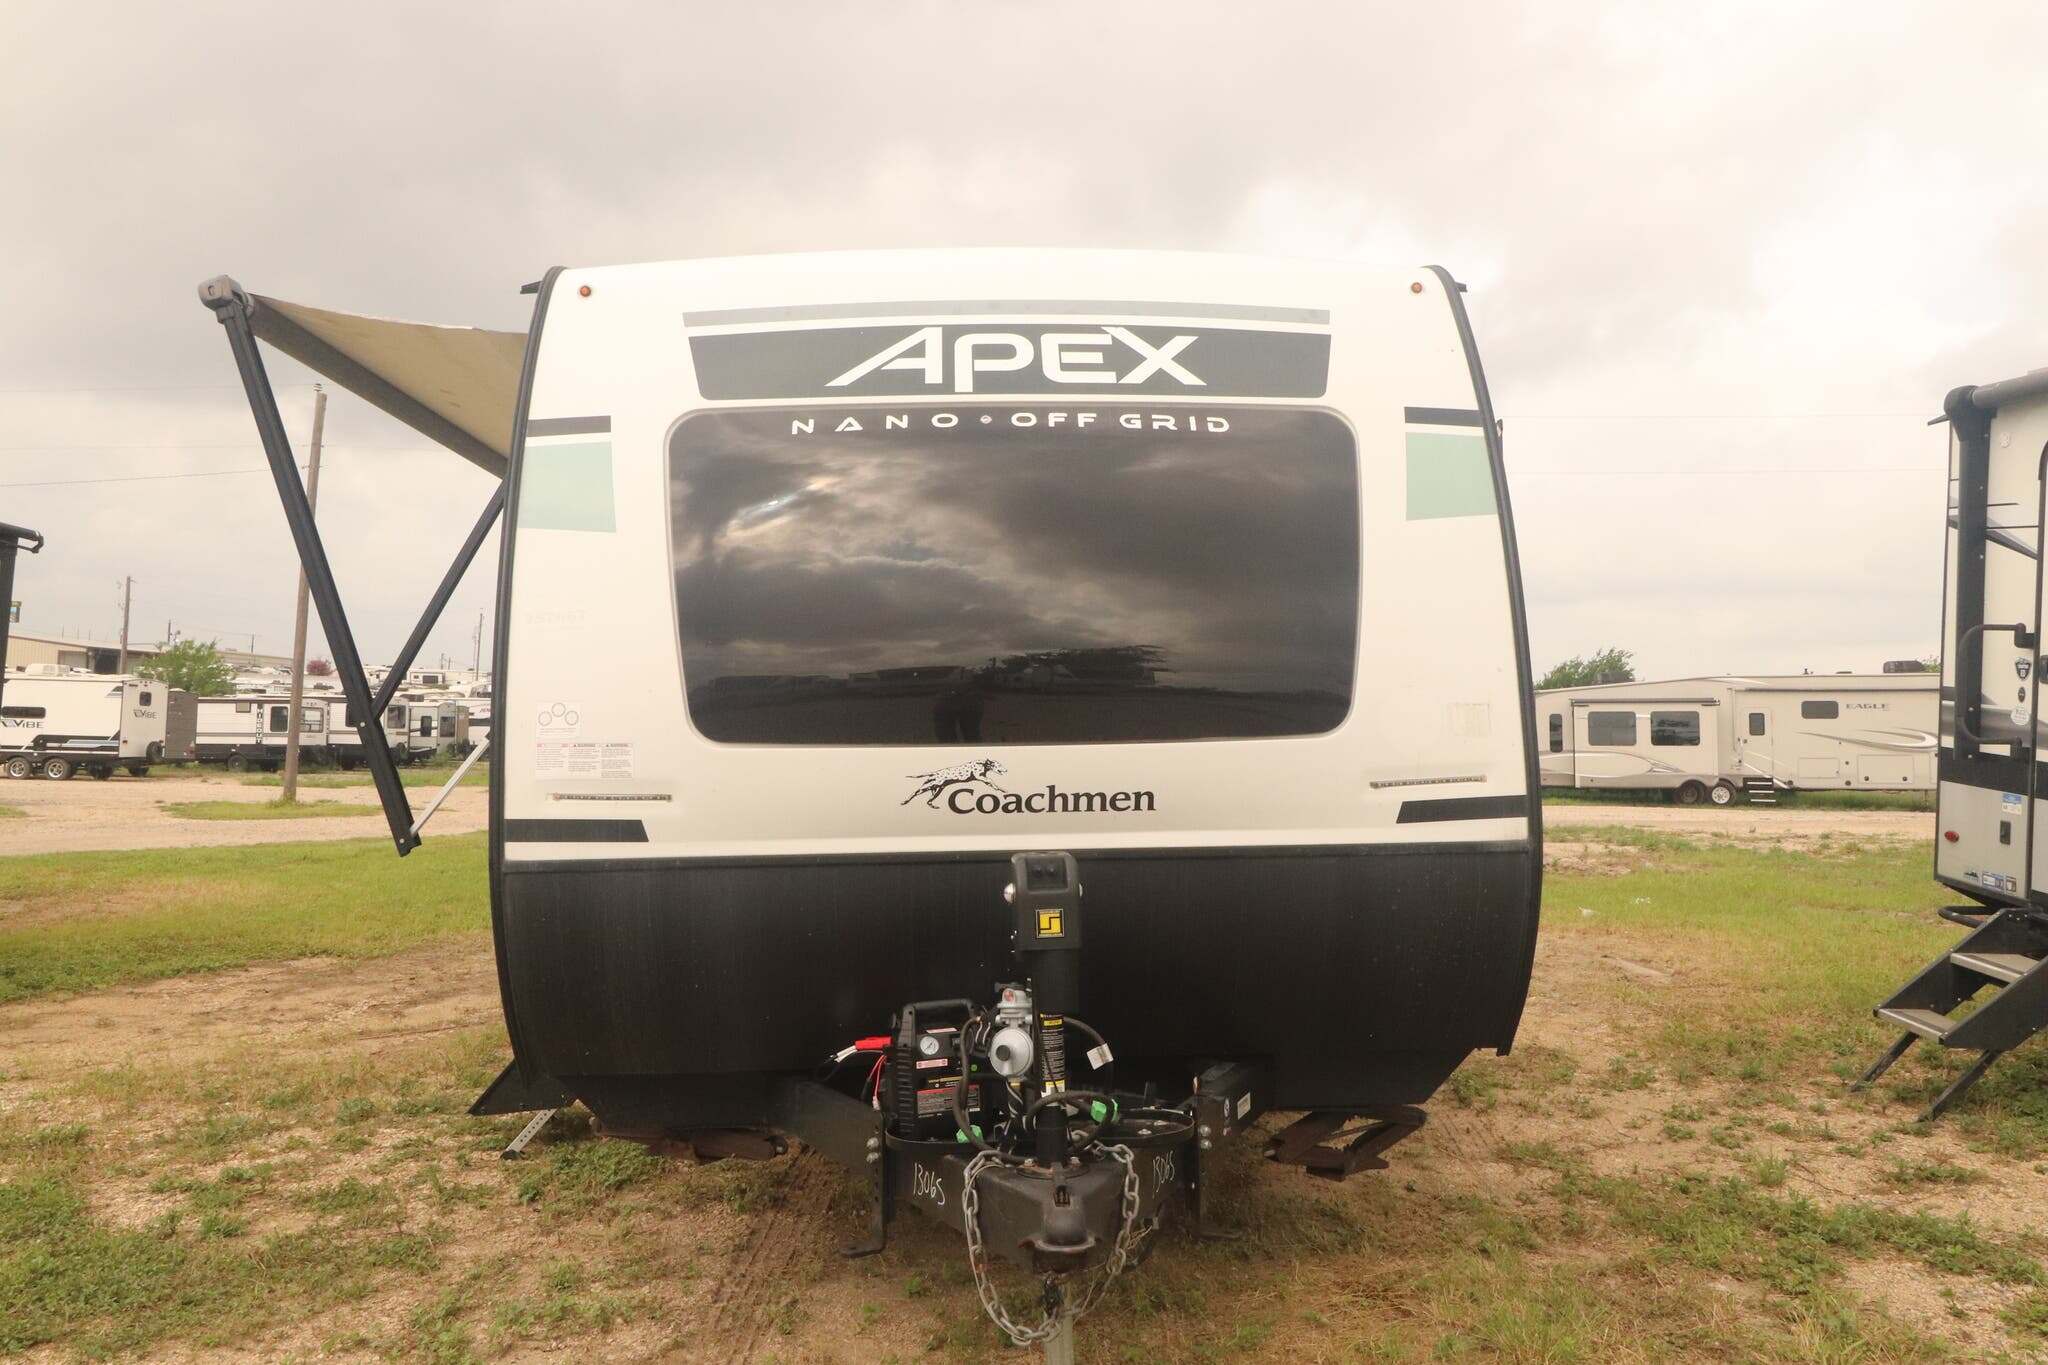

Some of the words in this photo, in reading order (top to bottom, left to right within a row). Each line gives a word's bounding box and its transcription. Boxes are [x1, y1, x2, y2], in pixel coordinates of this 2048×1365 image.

[824, 325, 1208, 393] APEX
[792, 413, 959, 435] NANO
[1010, 412, 1098, 428] OFF
[1119, 413, 1230, 433] GRID
[948, 784, 1156, 814] Coachmen
